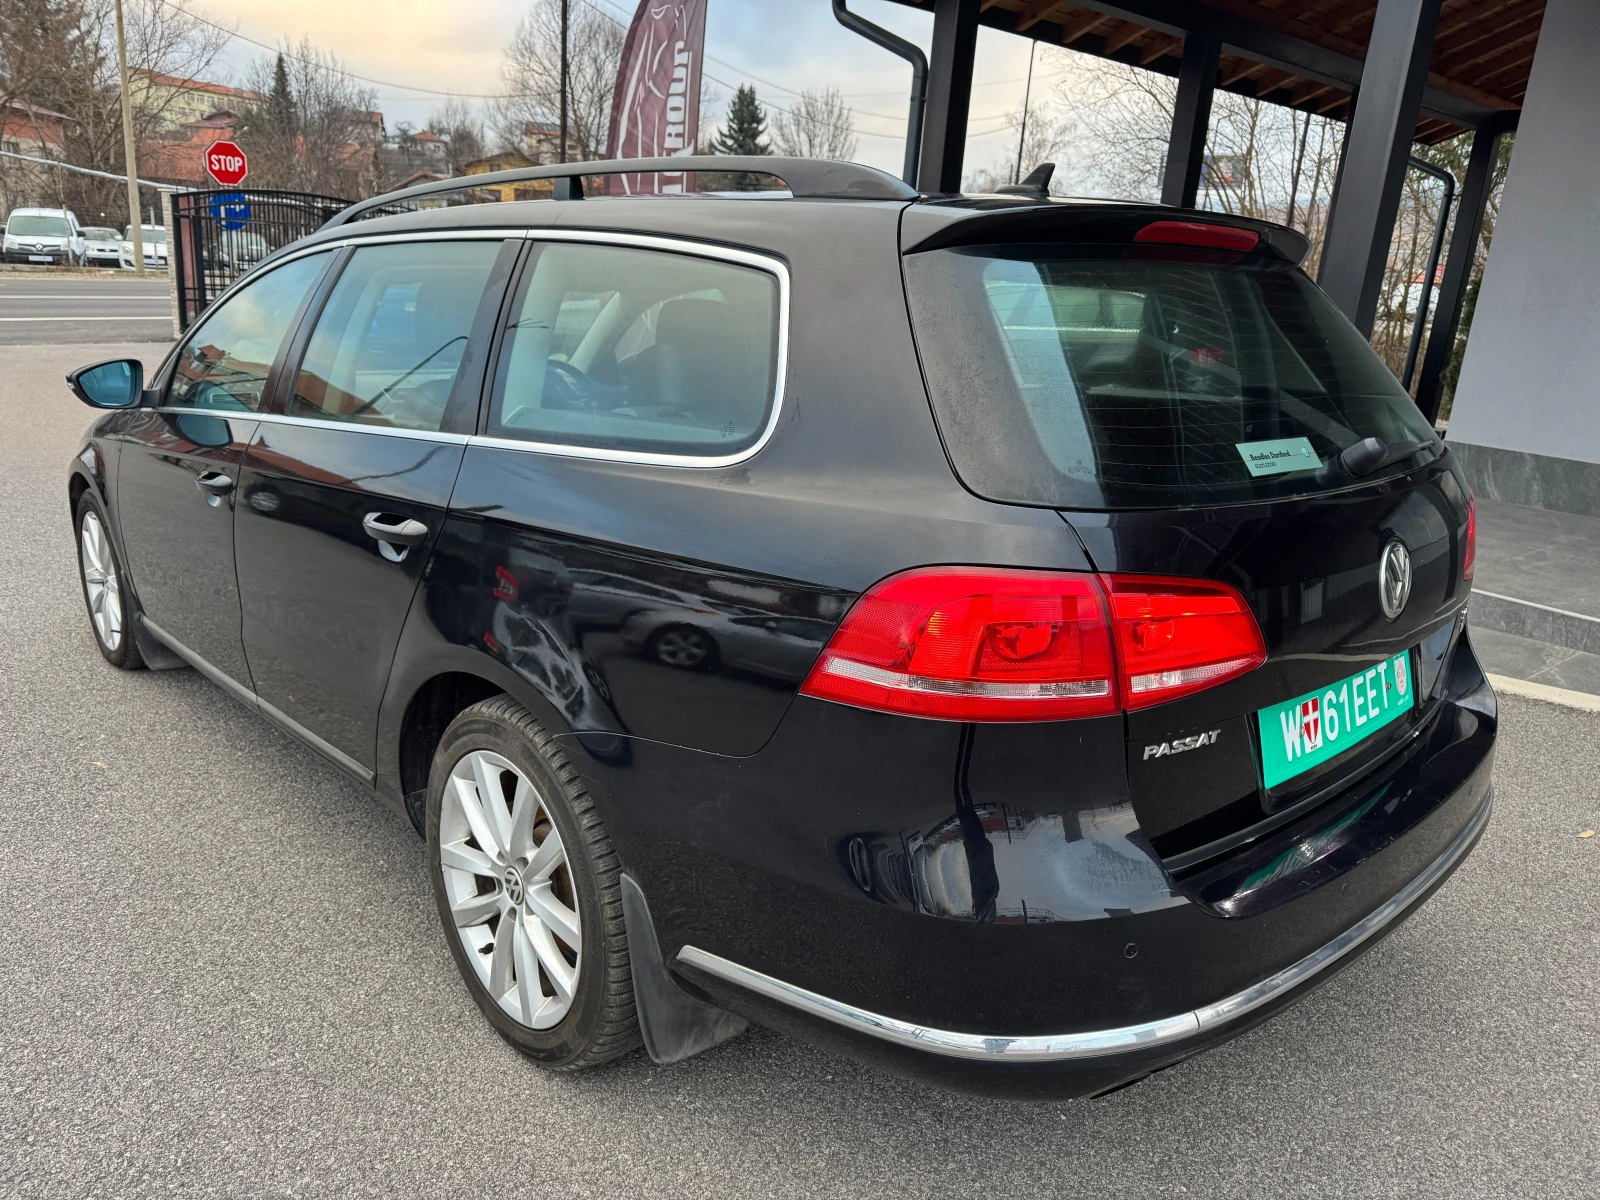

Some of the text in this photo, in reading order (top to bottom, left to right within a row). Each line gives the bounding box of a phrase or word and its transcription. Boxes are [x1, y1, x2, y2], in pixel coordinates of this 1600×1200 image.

[211, 154, 243, 172] STOP
[1279, 704, 1302, 762] W
[1323, 661, 1388, 742] 61EET
[1142, 729, 1221, 761] PASSAT
